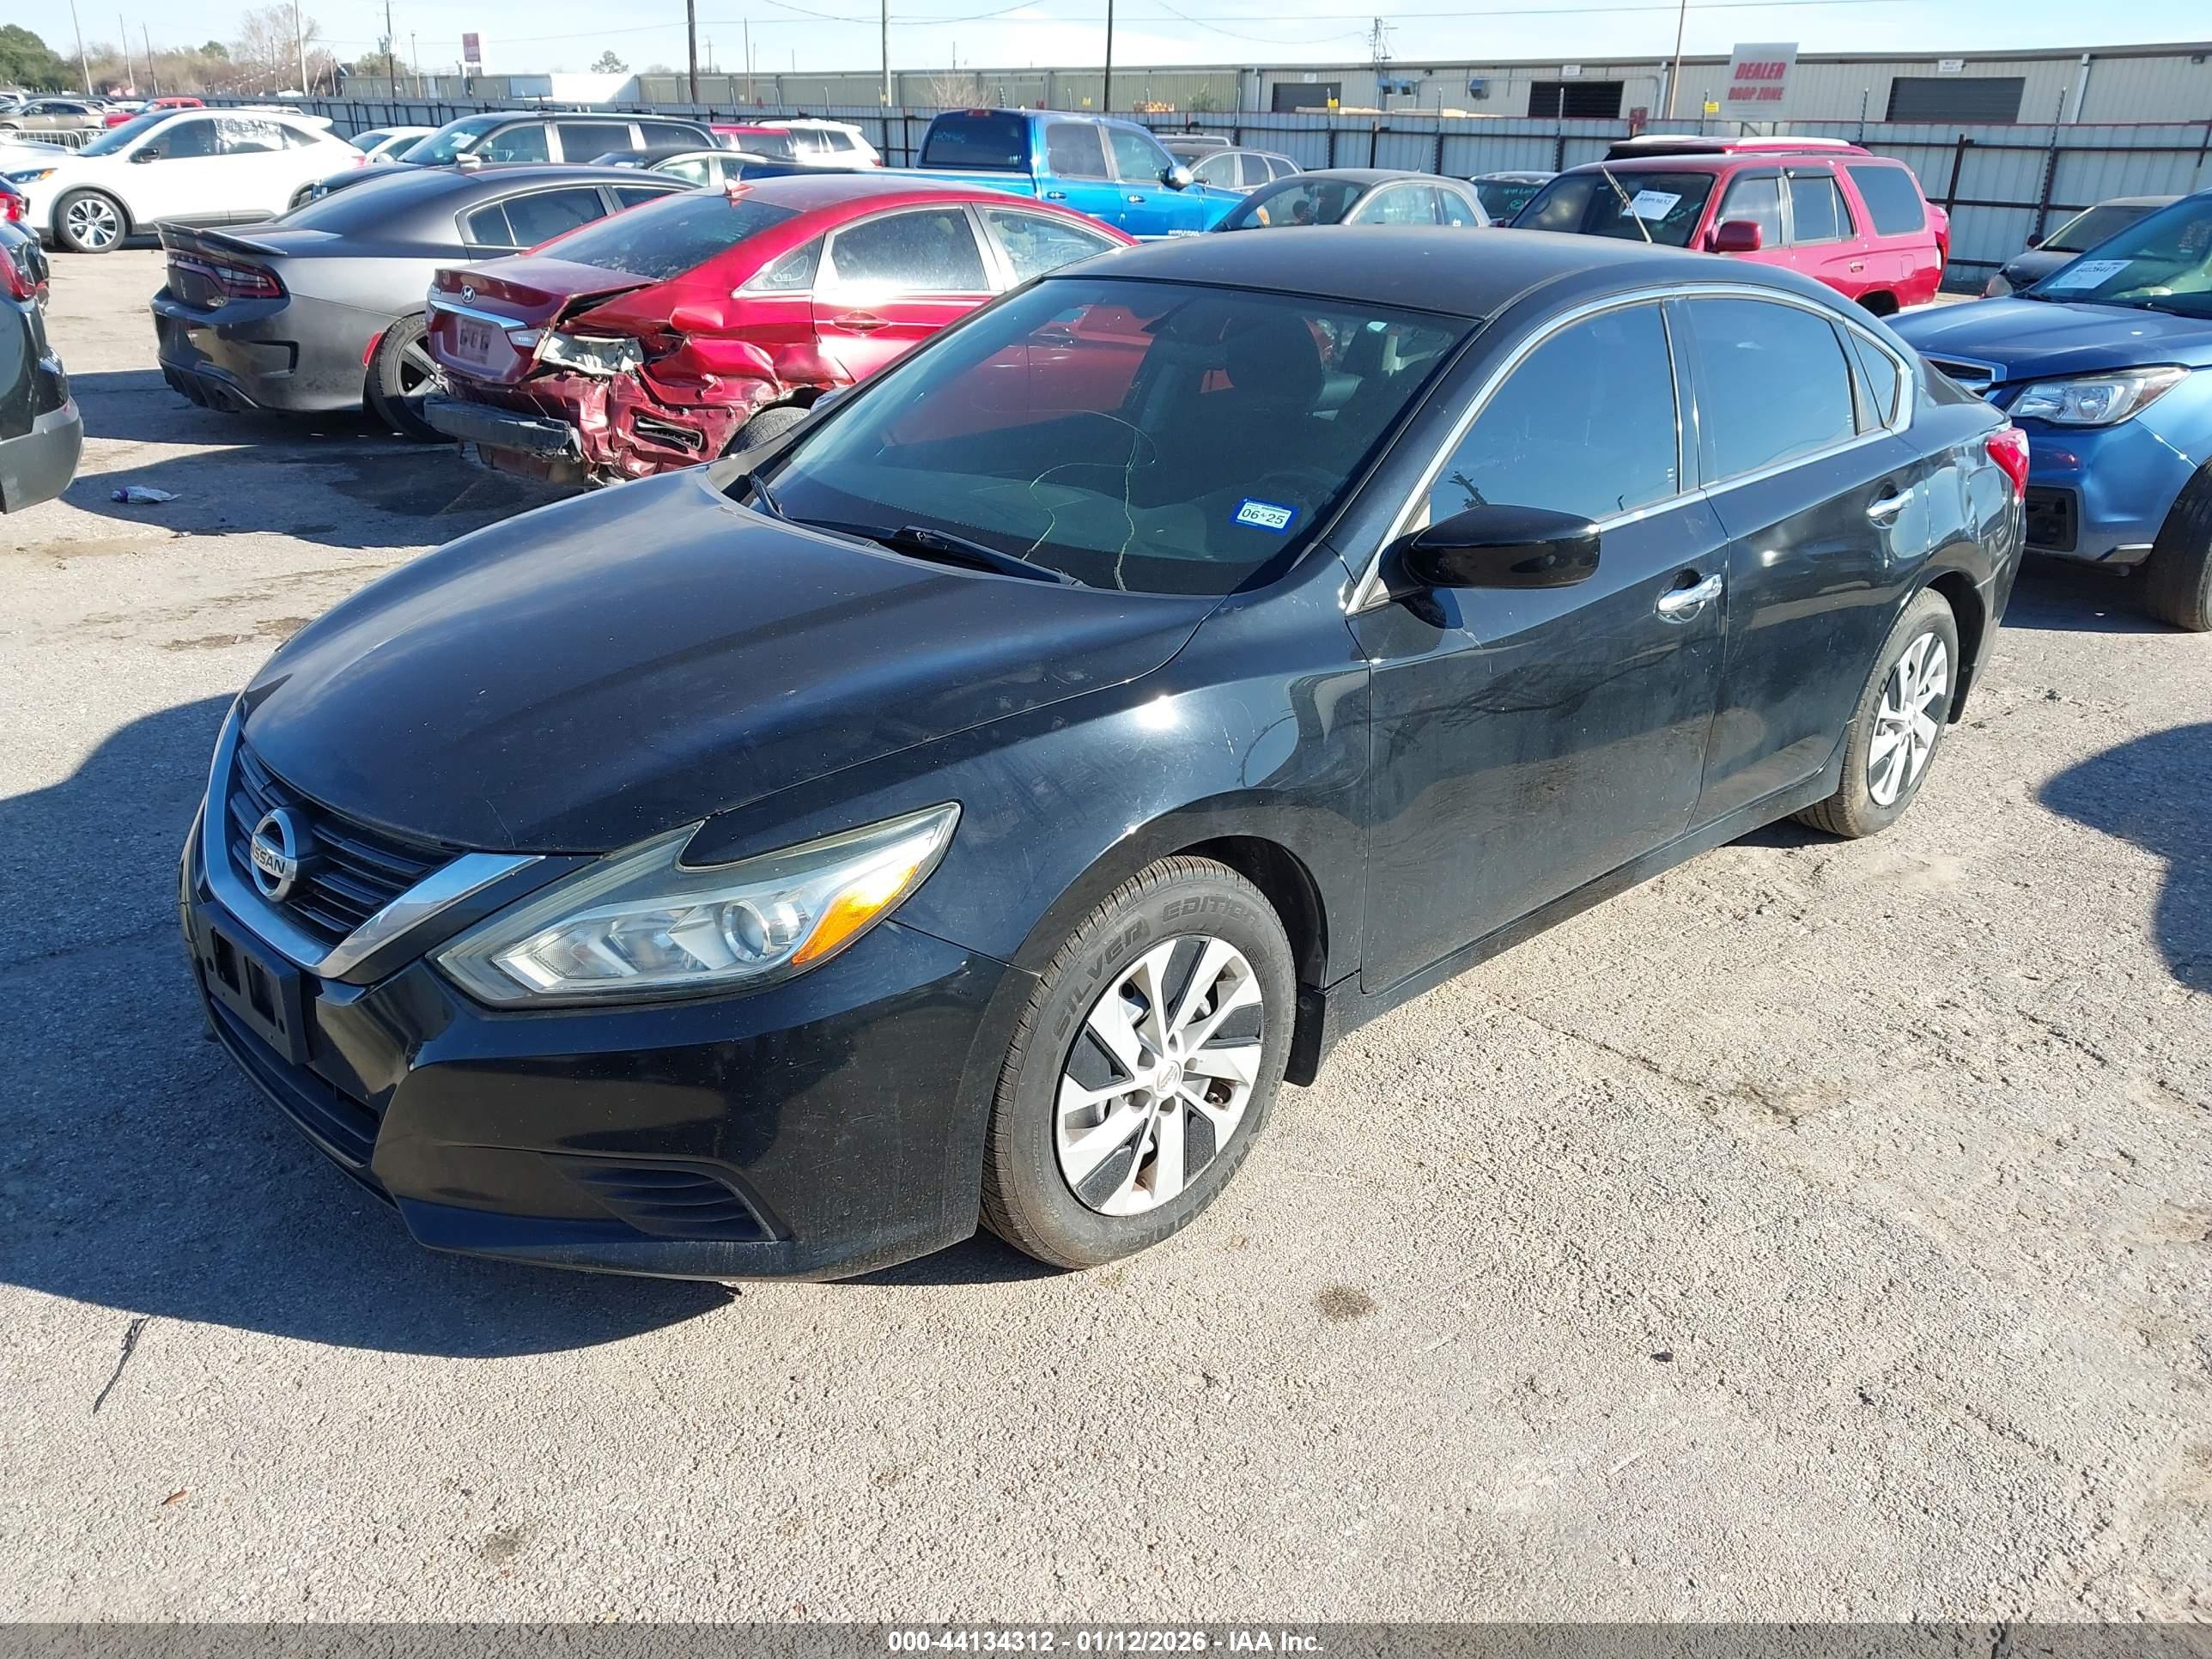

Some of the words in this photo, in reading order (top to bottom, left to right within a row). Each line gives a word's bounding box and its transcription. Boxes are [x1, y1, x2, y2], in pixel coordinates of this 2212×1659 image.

[1735, 62, 1787, 80] DEALER
[1727, 87, 1758, 100] DROP
[1757, 87, 1785, 100] ZONE
[251, 842, 286, 874] ISSAN
[1054, 918, 1147, 1042] SILVER
[1161, 895, 1257, 930] EDITION
